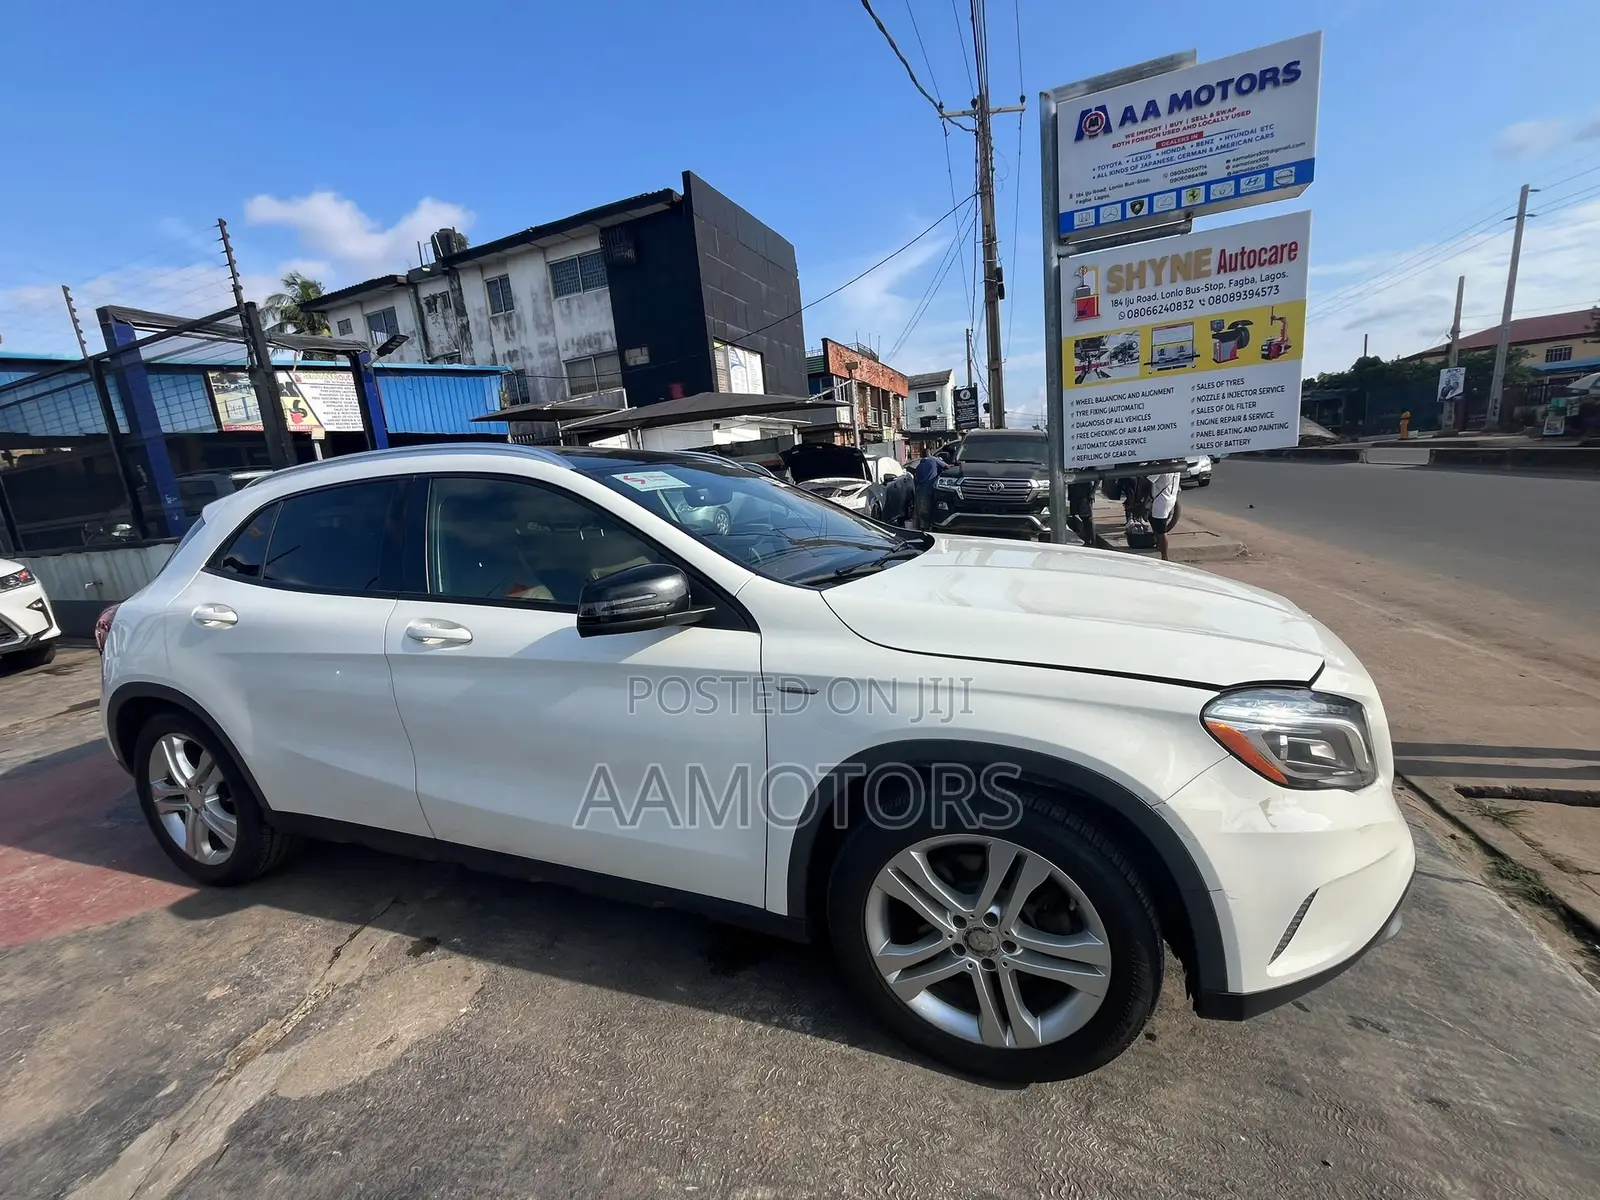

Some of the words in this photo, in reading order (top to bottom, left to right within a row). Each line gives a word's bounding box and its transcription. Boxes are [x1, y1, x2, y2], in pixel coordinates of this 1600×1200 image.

[1118, 99, 1161, 128] AA
[1167, 60, 1302, 115] MOTORS
[1112, 140, 1130, 149] BOTH
[1131, 132, 1161, 145] FOREIGN
[1162, 127, 1181, 136] USED
[1182, 123, 1197, 132] AND
[1198, 114, 1229, 127] LOCALLY
[1231, 109, 1251, 120] USED
[1136, 125, 1162, 136] IMPORT
[1169, 120, 1184, 128] BUY
[1191, 114, 1208, 123] SELL
[1215, 106, 1237, 117] SWAP
[1096, 171, 1108, 179] ALL
[1109, 166, 1129, 176] KINDS
[1177, 148, 1207, 160] GERMAN
[1215, 137, 1253, 152] AMERICAN
[1254, 132, 1275, 142] CARS
[1097, 160, 1123, 171] TOYOTA
[1131, 153, 1152, 163] LEXUS
[1161, 145, 1186, 156] HONDA
[1196, 138, 1214, 147] BENZ
[1224, 128, 1257, 141] HYUNDAI
[1260, 123, 1274, 132] ETC
[1106, 247, 1213, 294] SHYNE
[1216, 240, 1299, 275] Autocare
[1111, 299, 1123, 308] 184
[1124, 298, 1135, 308] Iju
[1161, 288, 1184, 299] Lonlo
[1228, 276, 1258, 288] Fagba,
[1260, 271, 1289, 283] Lagos.
[1127, 299, 1194, 319] 08066240832
[1208, 284, 1280, 306] 08089394573
[1196, 381, 1215, 391] SALES
[1215, 380, 1225, 388] OF
[1225, 377, 1245, 386] TYRES
[1075, 397, 1094, 406] WHEEL
[1095, 393, 1127, 404] BALANCING
[1127, 391, 1141, 399] AND
[1141, 386, 1175, 398] ALIGNMENT
[1196, 393, 1220, 403] NOZZLE
[1221, 392, 1226, 400] &
[1226, 388, 1258, 399] INJECTOR
[1258, 385, 1285, 395] SERVICE
[1076, 409, 1089, 417] TYRE
[1089, 406, 1108, 415] FIXING
[1196, 405, 1215, 415] SALES
[1215, 404, 1225, 412] OF
[1225, 403, 1235, 411] OIL
[1236, 401, 1257, 410] FILTER
[1076, 418, 1105, 428] DIAGNOSIS
[1105, 416, 1114, 425] OF
[1114, 415, 1125, 424] ALL
[1125, 413, 1151, 422] VEHICLES
[1196, 417, 1219, 427] ENGINE
[1219, 415, 1242, 424] REPAIR
[1242, 414, 1247, 422] &
[1248, 411, 1275, 420] SERVICE
[1076, 431, 1089, 440] FREE
[1090, 428, 1118, 438] CHECKING
[1118, 427, 1127, 435] OF
[1127, 426, 1138, 434] AIR
[1142, 424, 1156, 432] ARM
[1156, 422, 1177, 431] JOINTS
[1195, 429, 1215, 438] PANEL
[1216, 427, 1243, 436] BEATING
[1243, 425, 1258, 433] AND
[1258, 422, 1289, 432] PAINTING
[1076, 441, 1108, 451] AUTOMATIC
[1108, 439, 1124, 447] GEAR
[1124, 436, 1147, 446] SERVICE
[1195, 441, 1214, 450] SALES
[1214, 439, 1224, 448] OF
[1224, 438, 1252, 447] BATTERY
[1076, 452, 1103, 462] REFILLING
[1103, 451, 1112, 459] OF
[1112, 450, 1127, 458] GEAR
[1127, 449, 1137, 457] OIL
